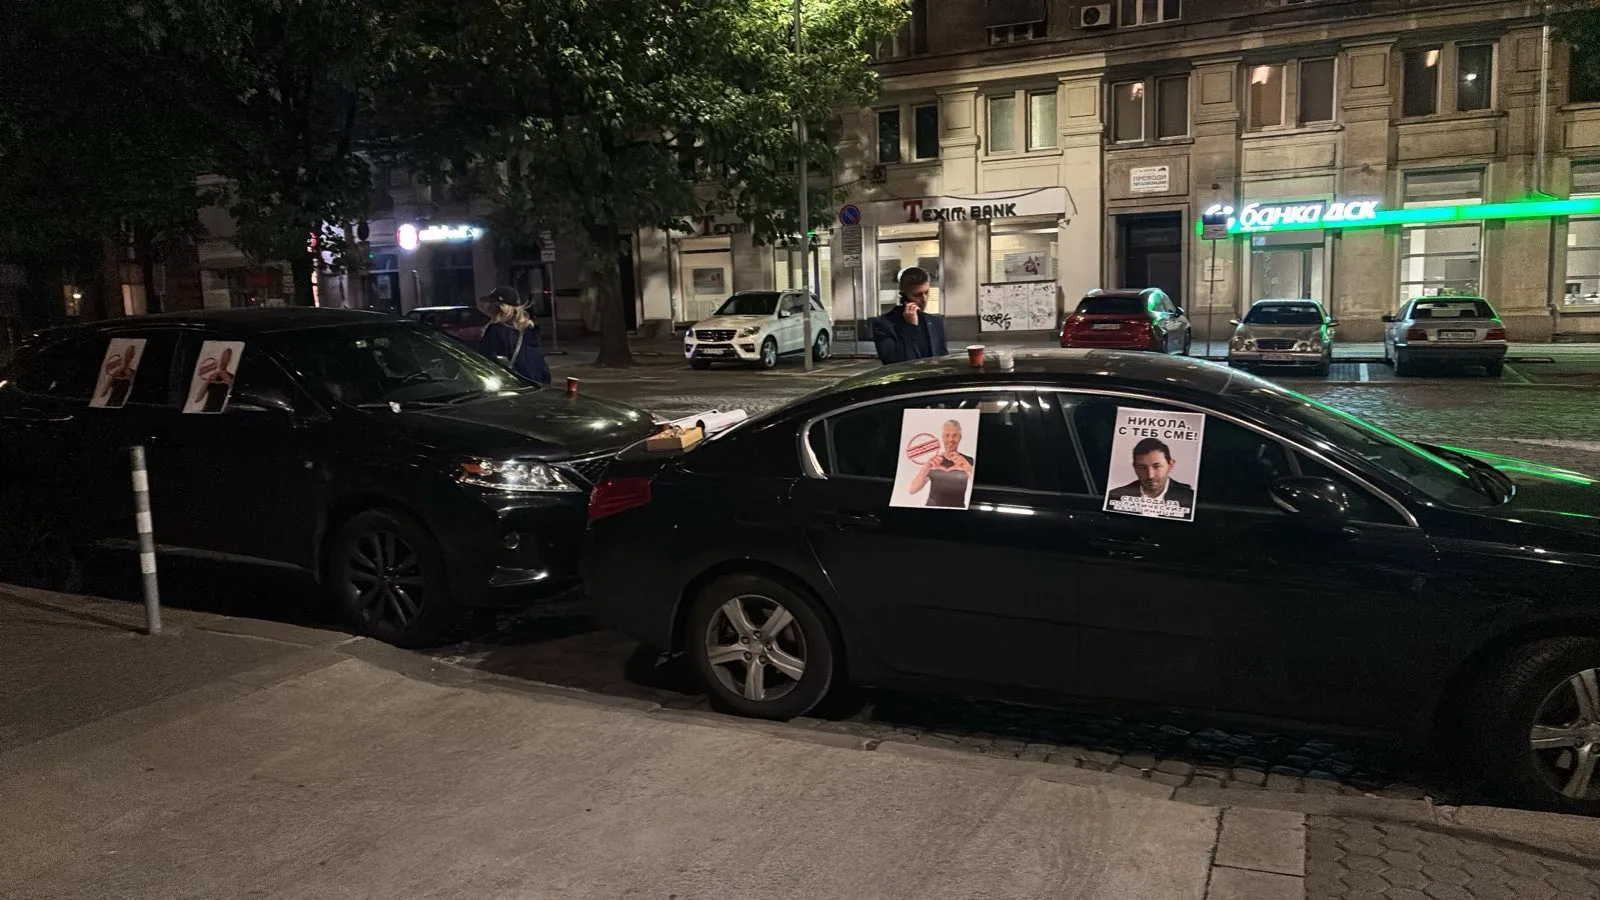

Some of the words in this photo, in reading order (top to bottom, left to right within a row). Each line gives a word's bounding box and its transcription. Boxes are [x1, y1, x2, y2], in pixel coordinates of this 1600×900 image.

[1240, 202, 1317, 227] банка
[1127, 416, 1191, 431] НИКОЛА,
[1118, 426, 1127, 435] С
[1132, 427, 1159, 438] ТЕБ
[1163, 430, 1198, 441] СМЕ!
